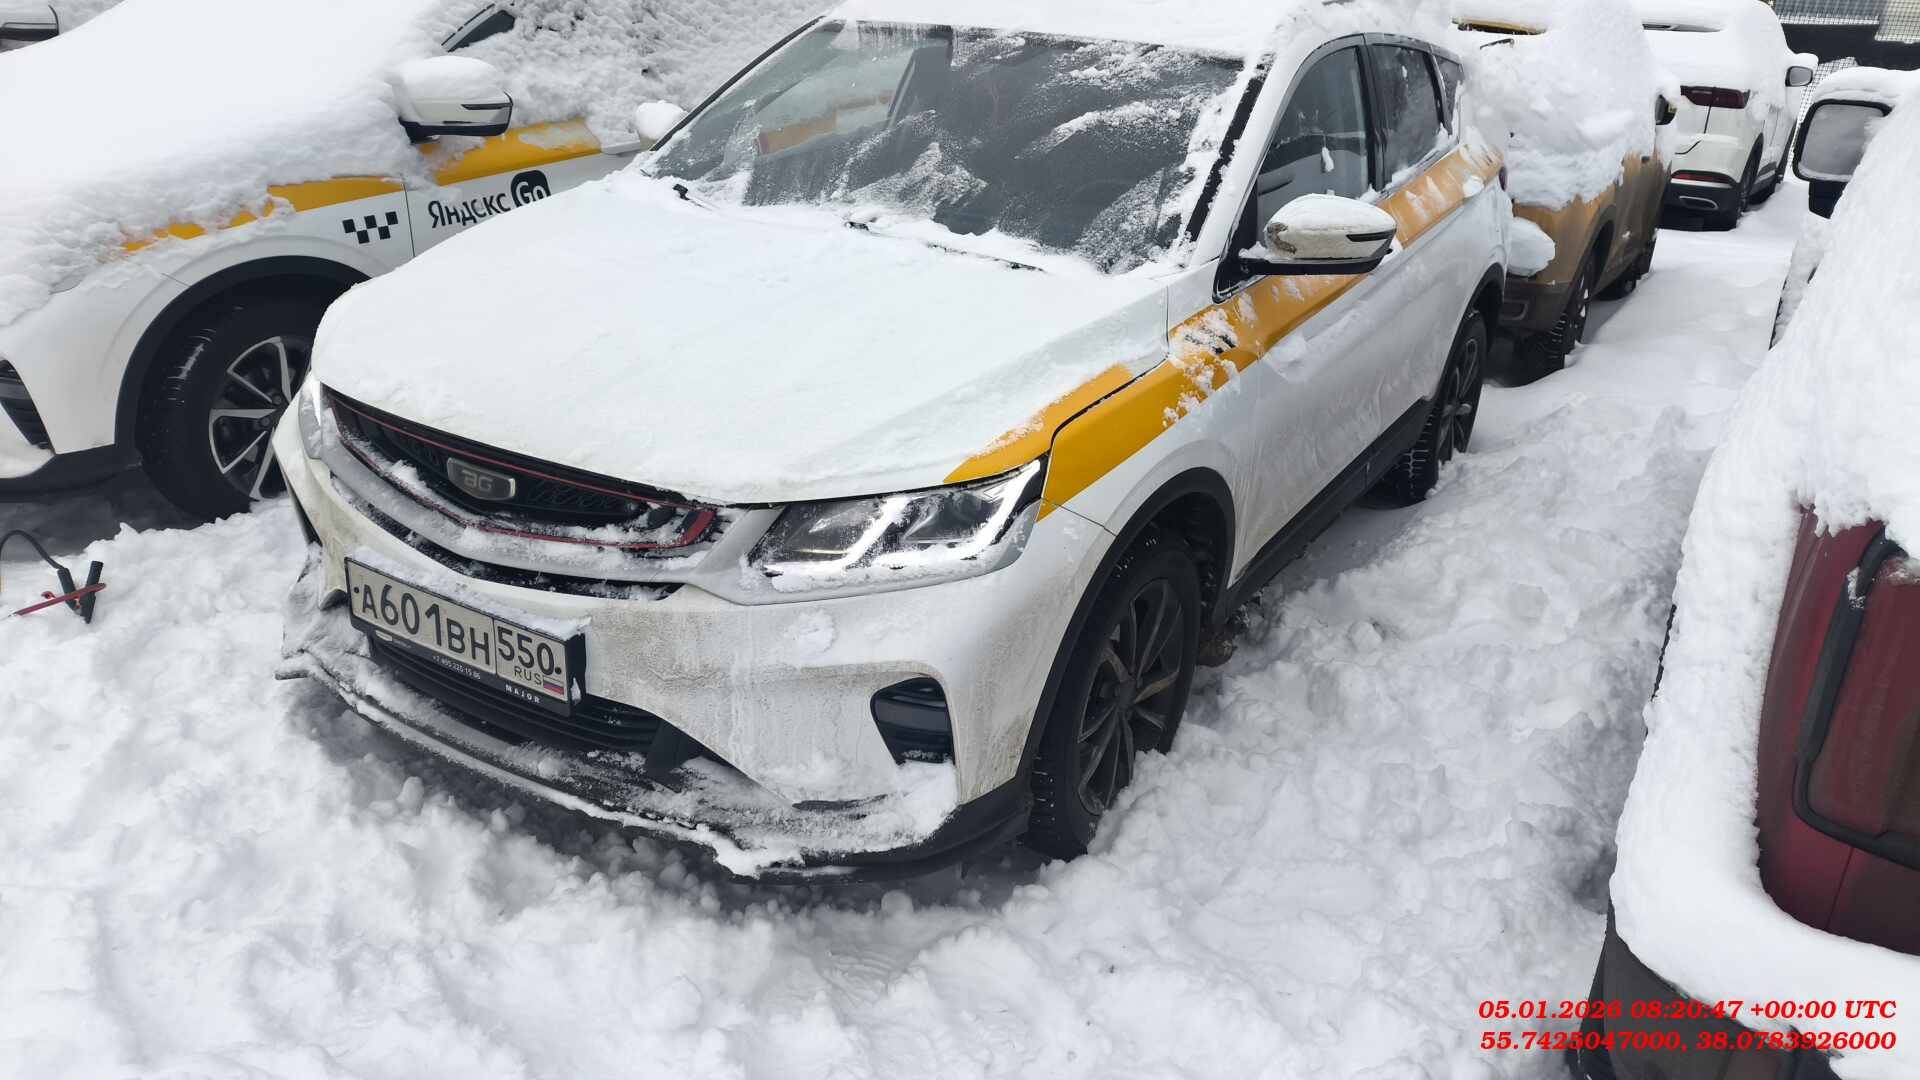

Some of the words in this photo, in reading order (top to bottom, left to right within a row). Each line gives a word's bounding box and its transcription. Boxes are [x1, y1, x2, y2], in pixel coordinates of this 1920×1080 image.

[362, 584, 490, 666] А601ВН
[497, 625, 555, 676] 550
[514, 667, 542, 685] RUS
[505, 684, 540, 703] MAJOR
